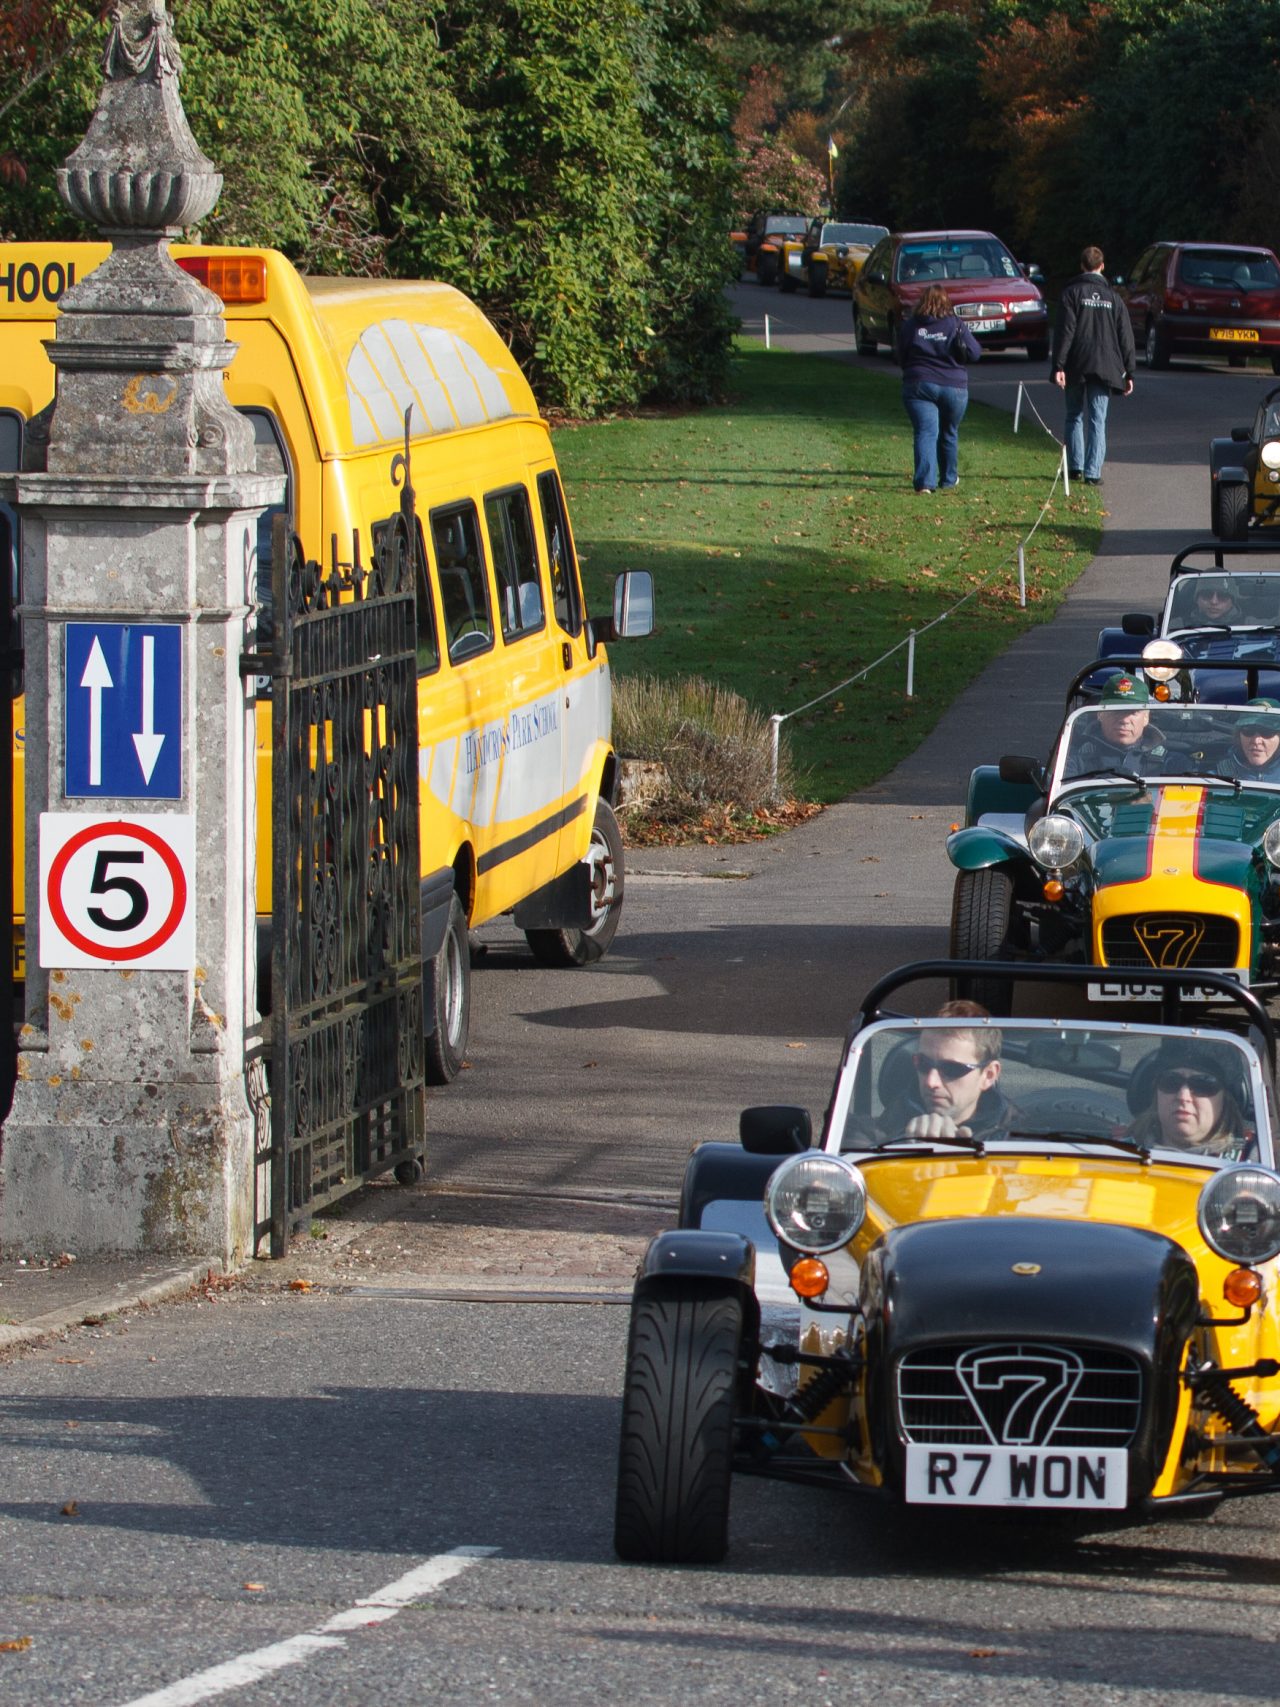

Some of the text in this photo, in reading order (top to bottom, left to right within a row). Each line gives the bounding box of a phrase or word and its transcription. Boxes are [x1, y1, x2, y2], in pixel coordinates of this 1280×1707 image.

[965, 321, 981, 331] 27
[87, 850, 149, 932] 5
[973, 1355, 1068, 1443] 7
[928, 1451, 1106, 1500] R7 WON
